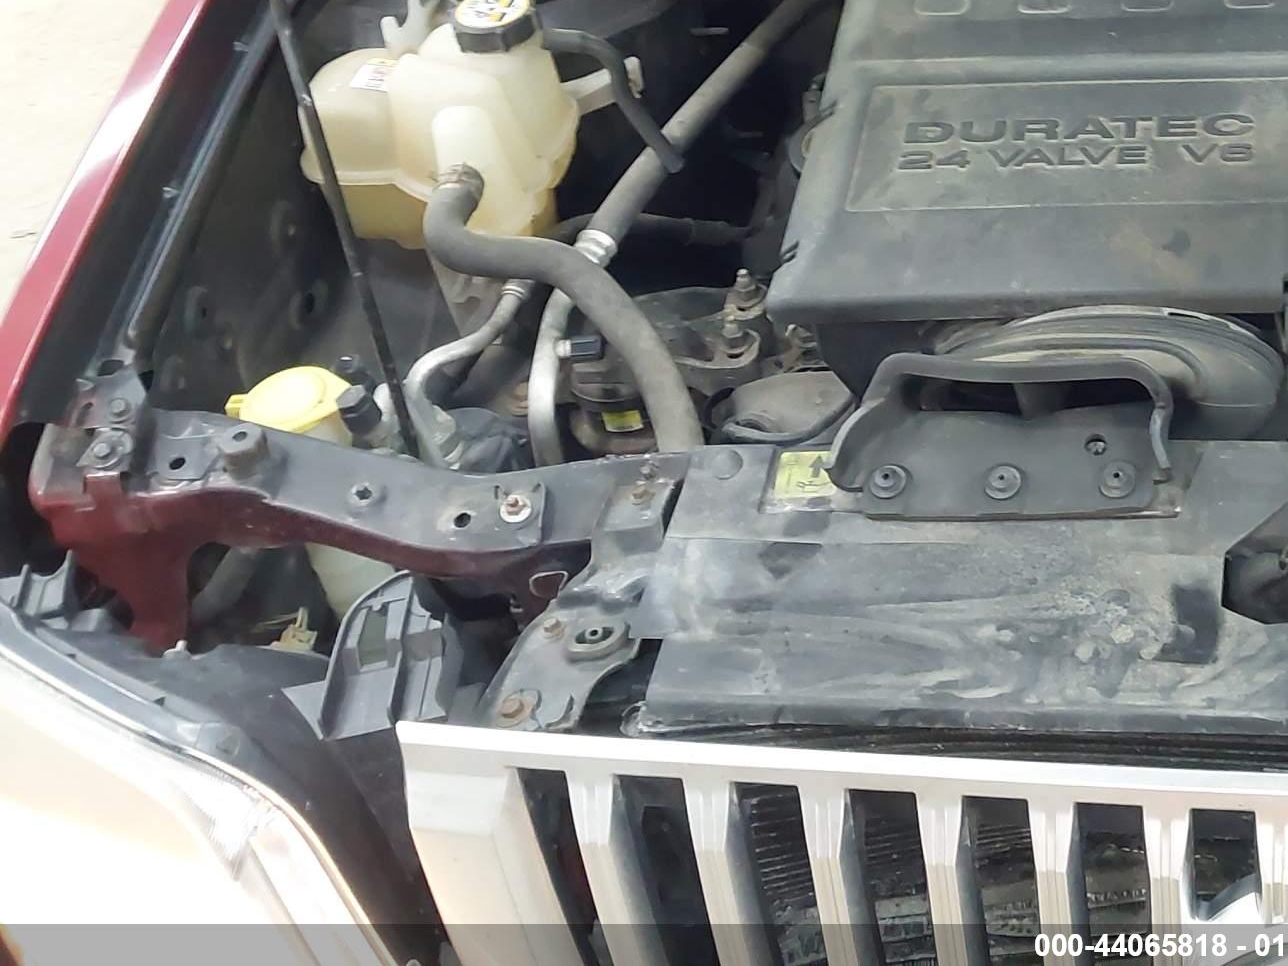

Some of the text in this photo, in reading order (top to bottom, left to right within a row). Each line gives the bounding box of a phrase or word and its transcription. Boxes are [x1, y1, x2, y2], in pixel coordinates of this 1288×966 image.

[903, 114, 1255, 144] DURATEC
[898, 149, 971, 170] 24
[988, 145, 1151, 169] VALVE
